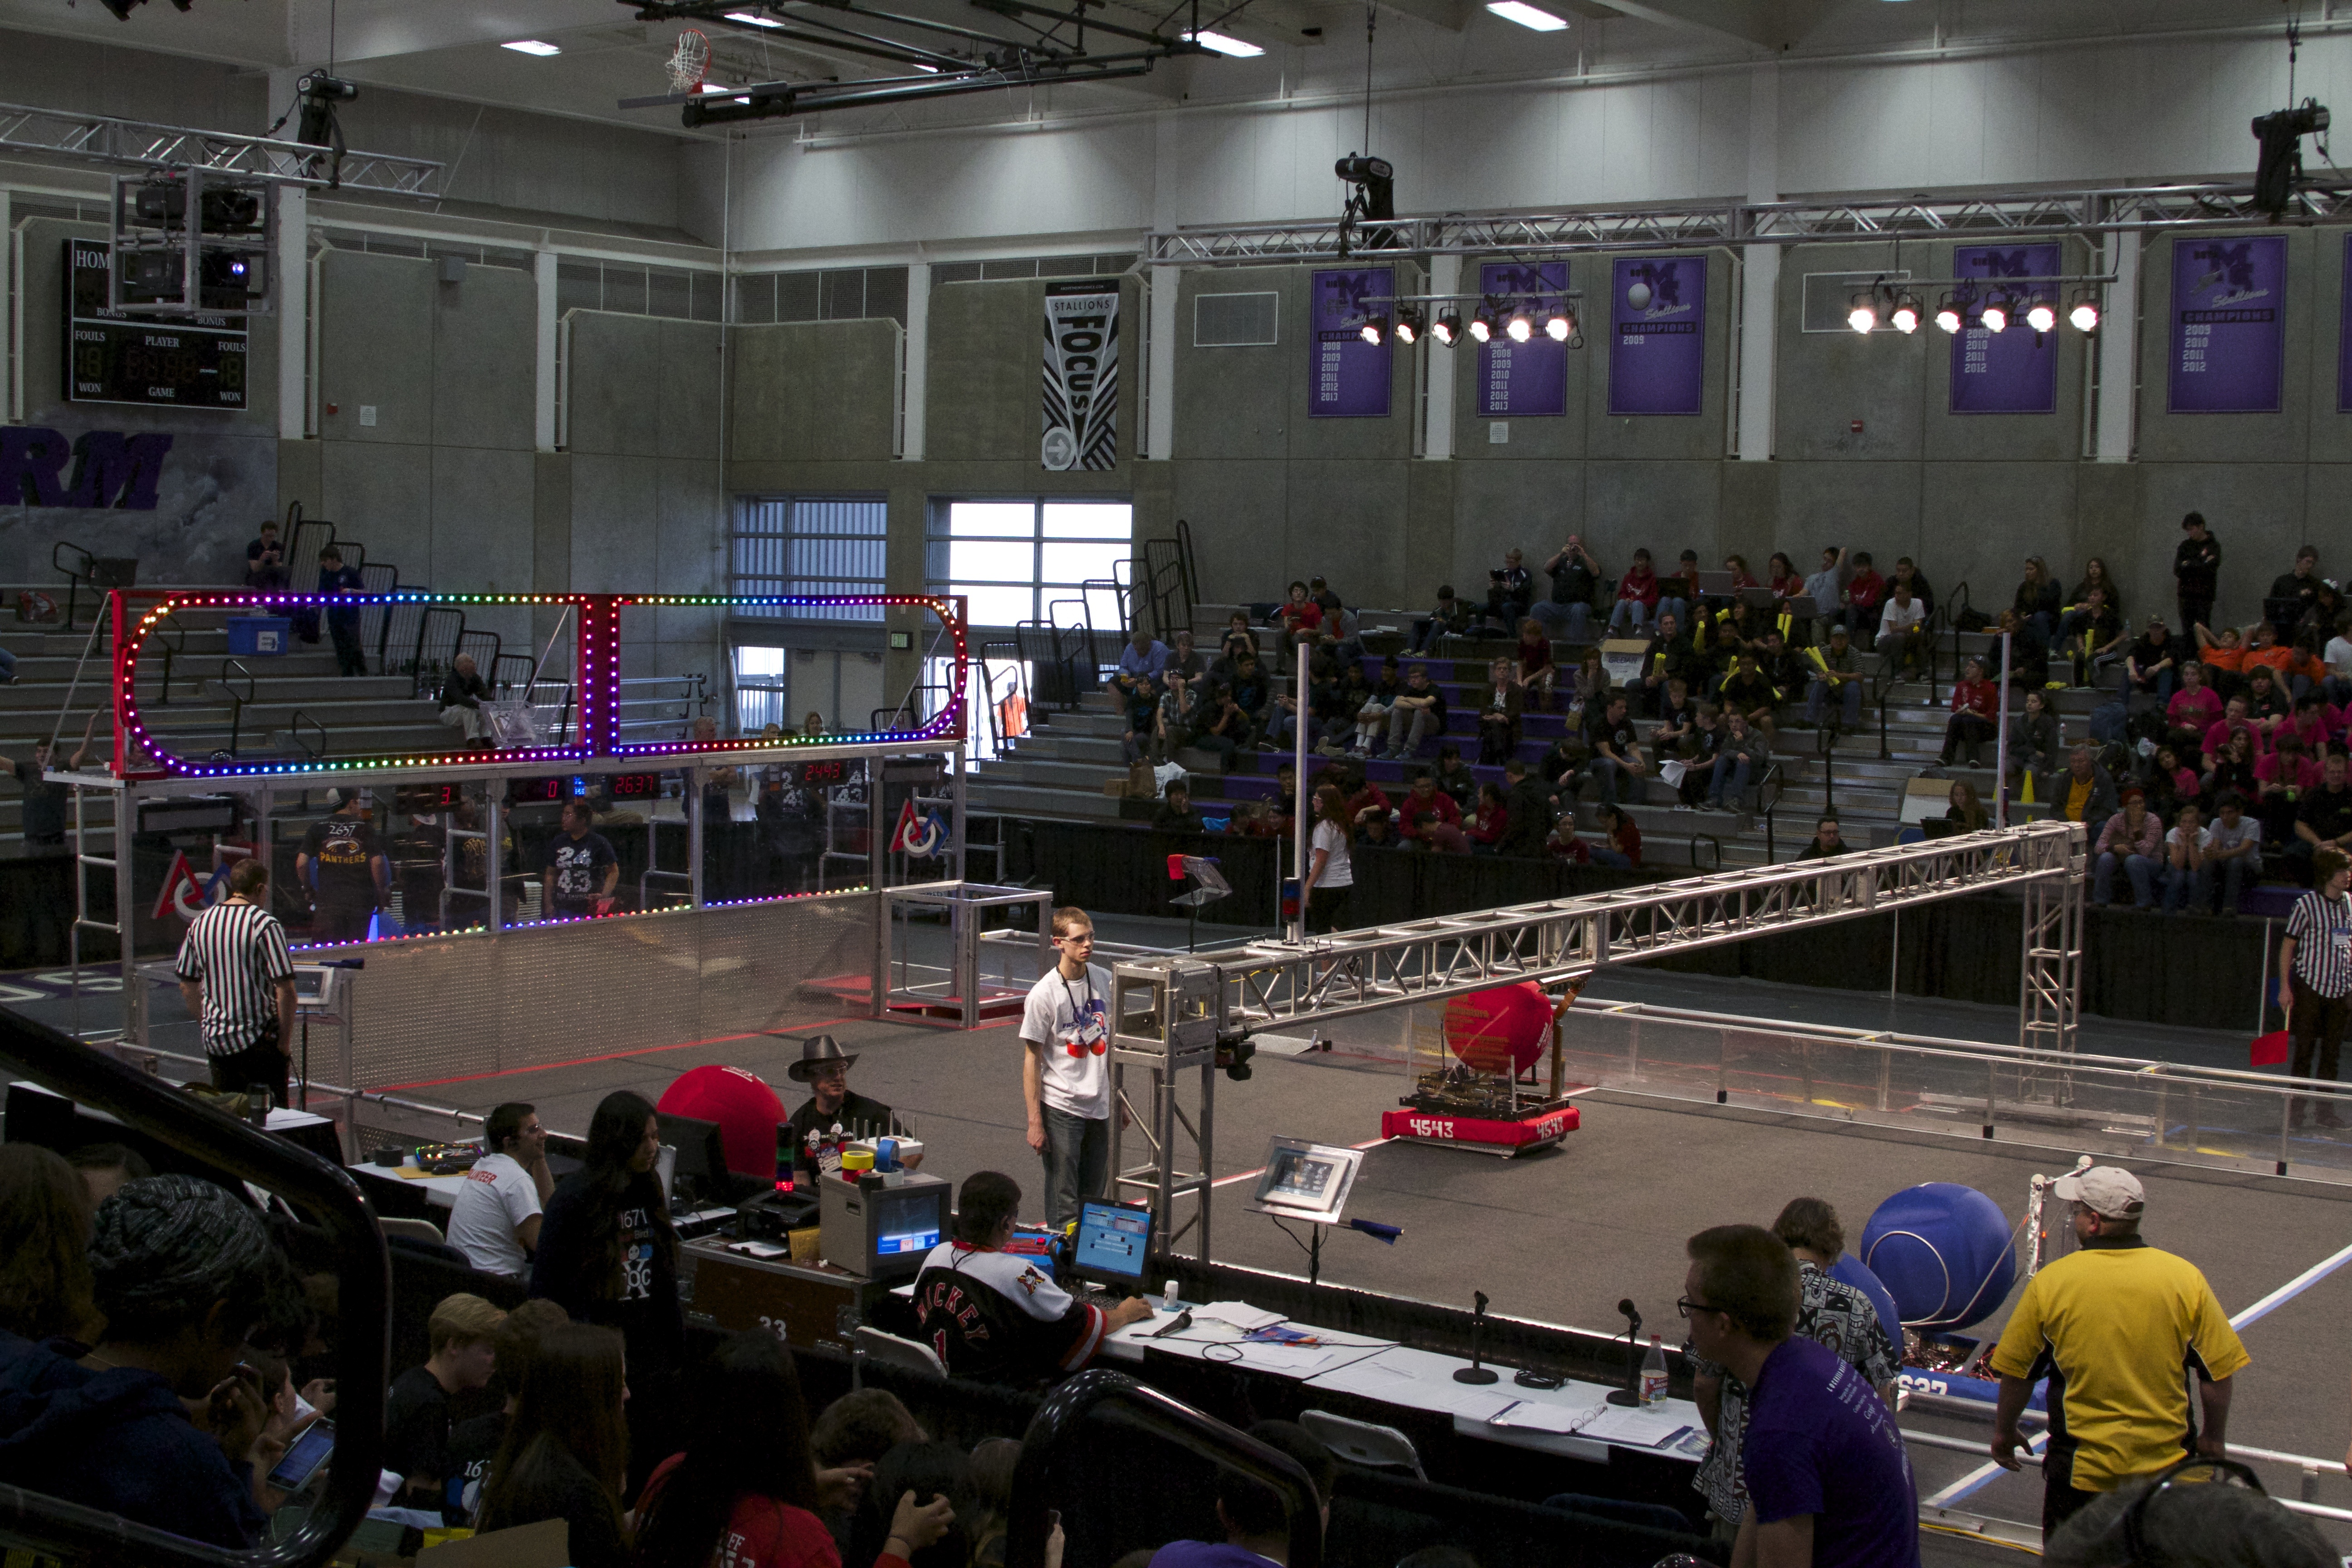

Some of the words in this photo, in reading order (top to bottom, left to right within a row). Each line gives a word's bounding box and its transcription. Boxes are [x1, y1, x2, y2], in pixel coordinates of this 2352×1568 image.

[75, 250, 110, 270] HOM
[1054, 300, 1110, 311] STALLIONS
[197, 316, 226, 326] BONUS
[2185, 311, 2271, 322] CHAMPIONS
[1622, 323, 1693, 333] CHAMPIONS
[2185, 325, 2211, 335] 2009
[75, 330, 105, 342] FOULS
[1967, 329, 1990, 339] 2009
[145, 336, 179, 348] PLAYER
[1623, 335, 1644, 345] 2009
[1966, 340, 1988, 350] 2010
[2185, 338, 2208, 348] 2010
[218, 341, 246, 352] FOULS
[1322, 342, 1341, 351] 2008
[1322, 353, 1340, 362] 2009
[1492, 349, 1511, 358] 2008
[1965, 352, 1985, 361] 2011
[2183, 350, 2204, 360] 2011
[1058, 315, 1107, 409] FOCUS
[1492, 360, 1511, 368] 2009
[2182, 362, 2206, 372] 2012
[1322, 363, 1338, 372] 2010
[1965, 363, 1986, 373] 2012
[1321, 373, 1337, 382] 2011
[1491, 370, 1509, 379] 2010
[78, 382, 101, 393] WON
[1321, 382, 1338, 391] 2012
[1491, 381, 1507, 390] 2011
[148, 387, 175, 397] GAME
[220, 391, 241, 401] WON
[1321, 392, 1338, 401] 2013
[1490, 391, 1509, 400] 2012
[1490, 401, 1508, 411] 2013
[805, 763, 841, 781] 2443
[548, 781, 558, 798] 0
[615, 776, 653, 794] 2637
[441, 787, 451, 804] 3
[329, 824, 356, 837] 2637
[319, 852, 366, 864] PANTHERS
[556, 847, 593, 868] 24
[558, 869, 592, 893] 43
[1410, 1118, 1454, 1138] 4543
[1536, 1116, 1564, 1140] 4543
[620, 1208, 648, 1229] 1671
[1891, 1374, 1948, 1395] 637
